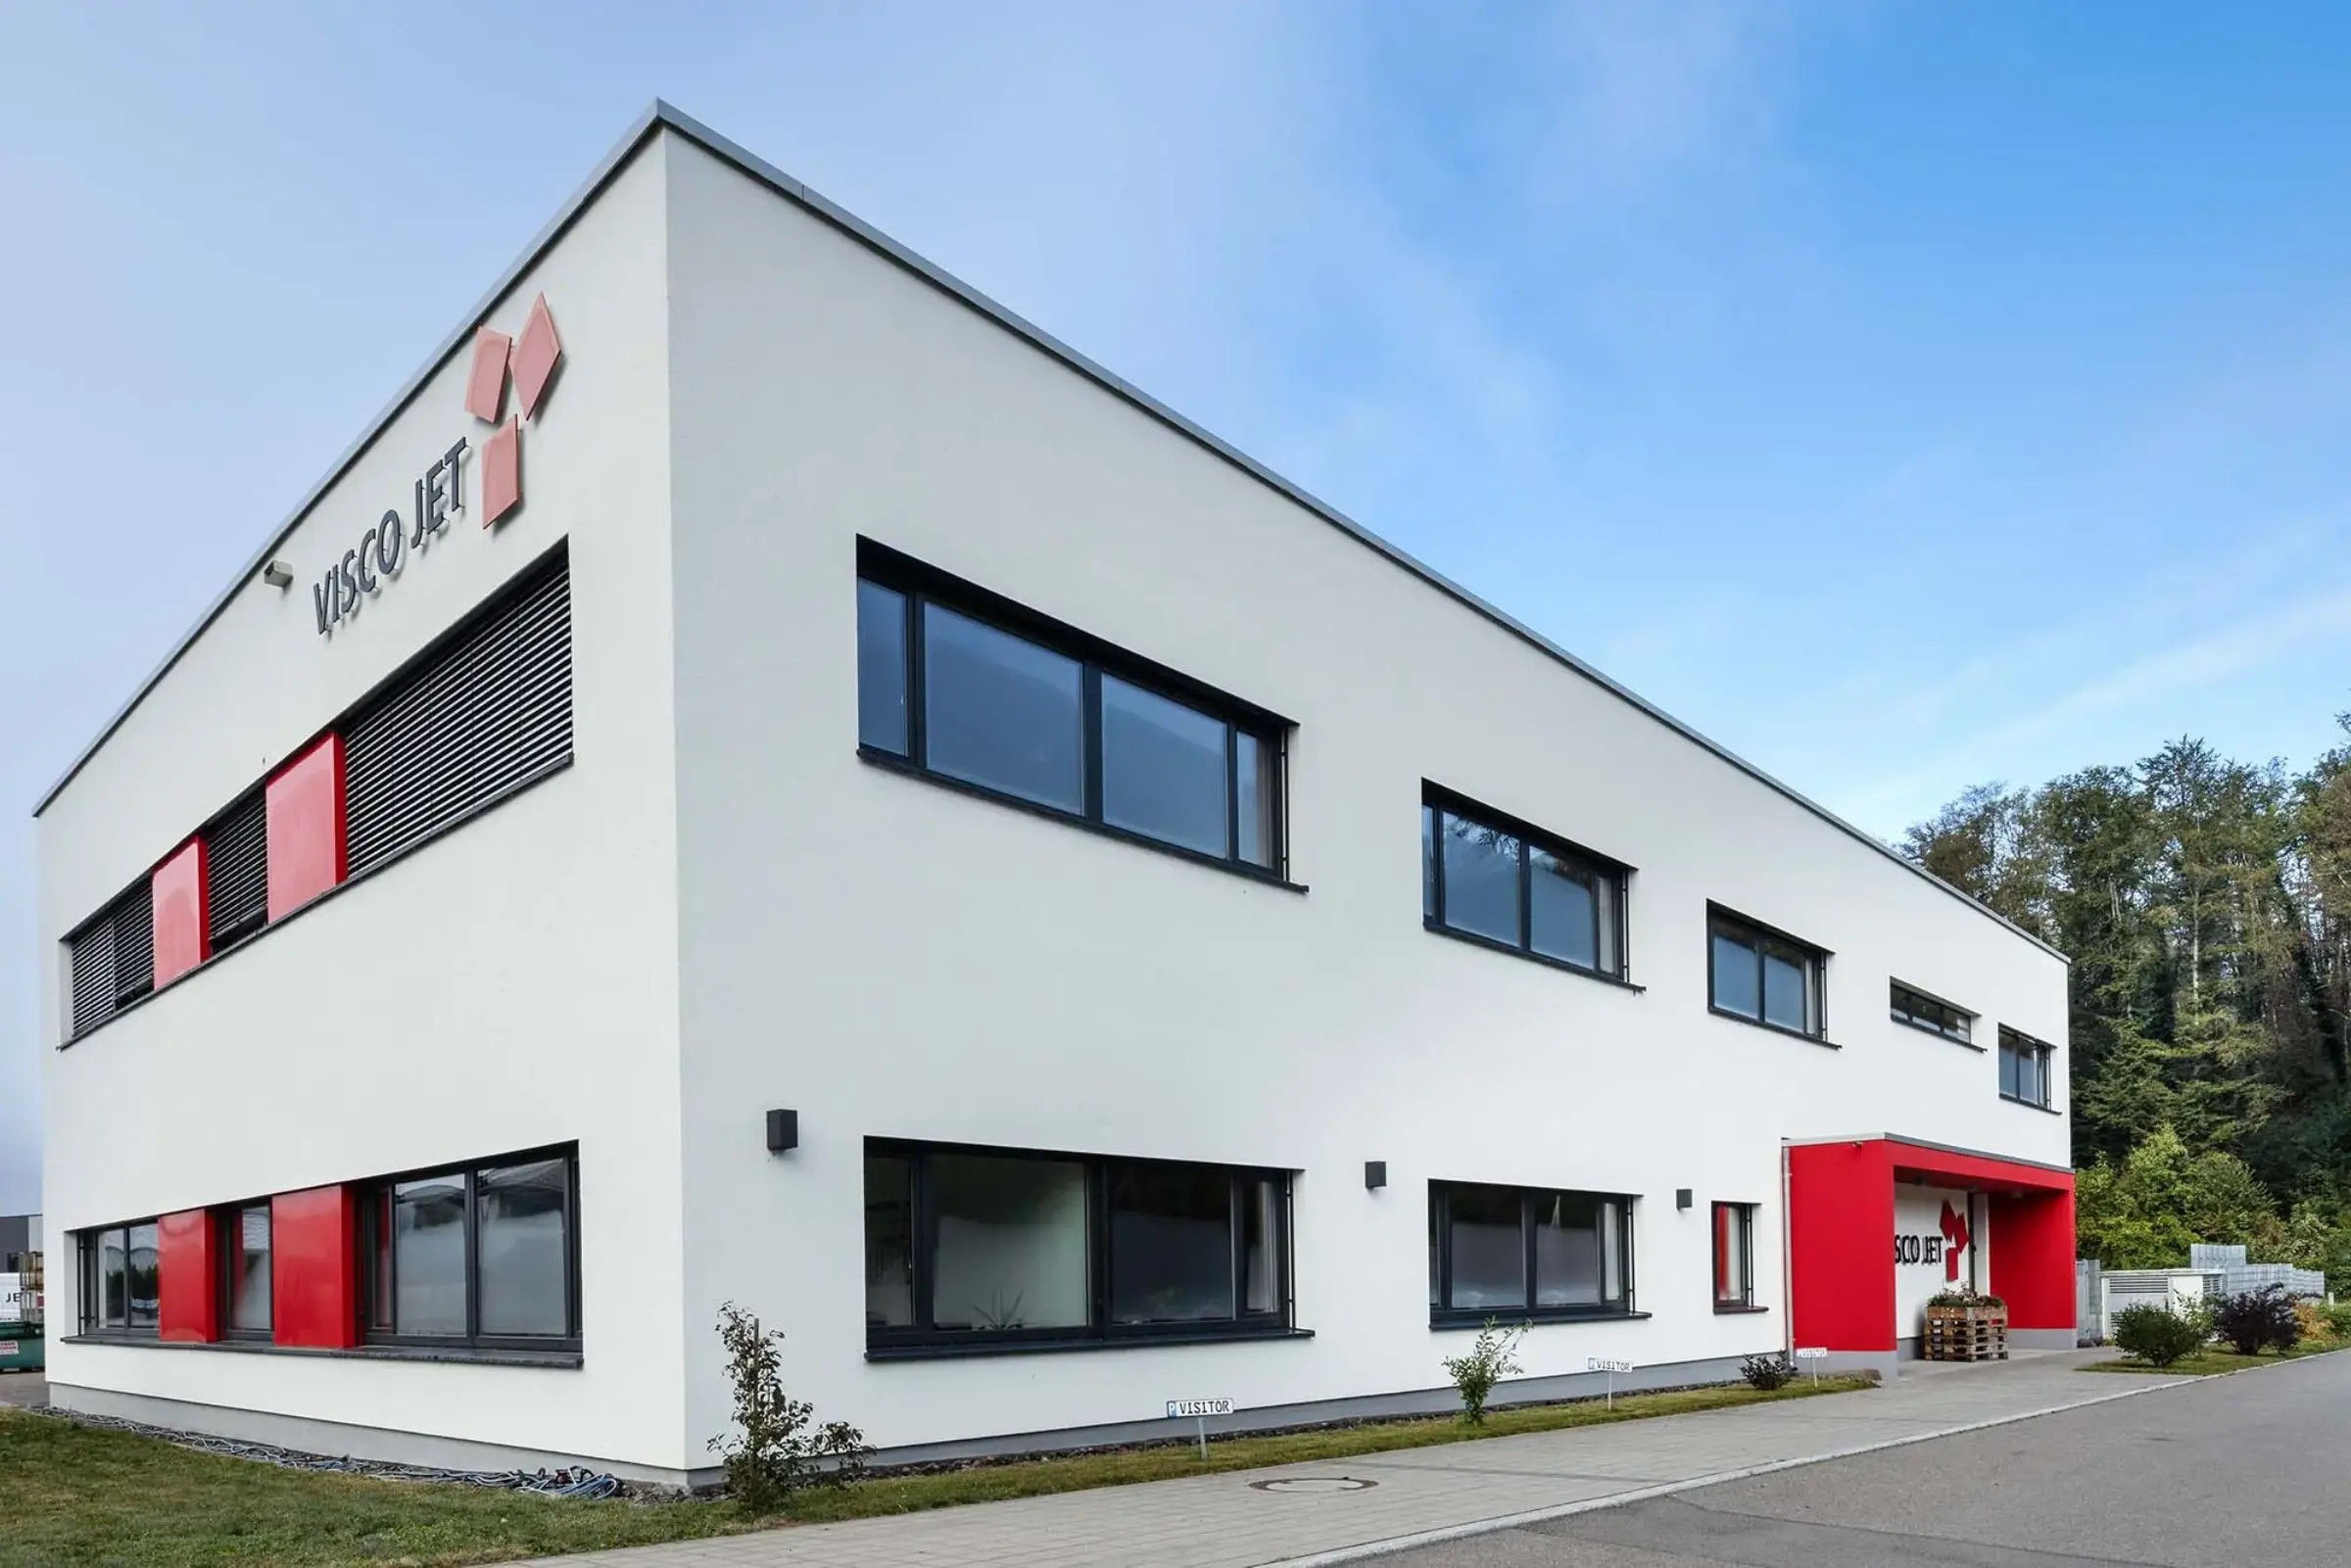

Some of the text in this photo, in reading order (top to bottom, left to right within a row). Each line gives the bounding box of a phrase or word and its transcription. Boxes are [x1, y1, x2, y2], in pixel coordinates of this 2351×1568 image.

[312, 436, 468, 635] VISCO JET
[1921, 1235, 1943, 1264] JET
[1597, 1360, 1630, 1371] VISITOR
[1179, 1400, 1229, 1414] VISITOR
